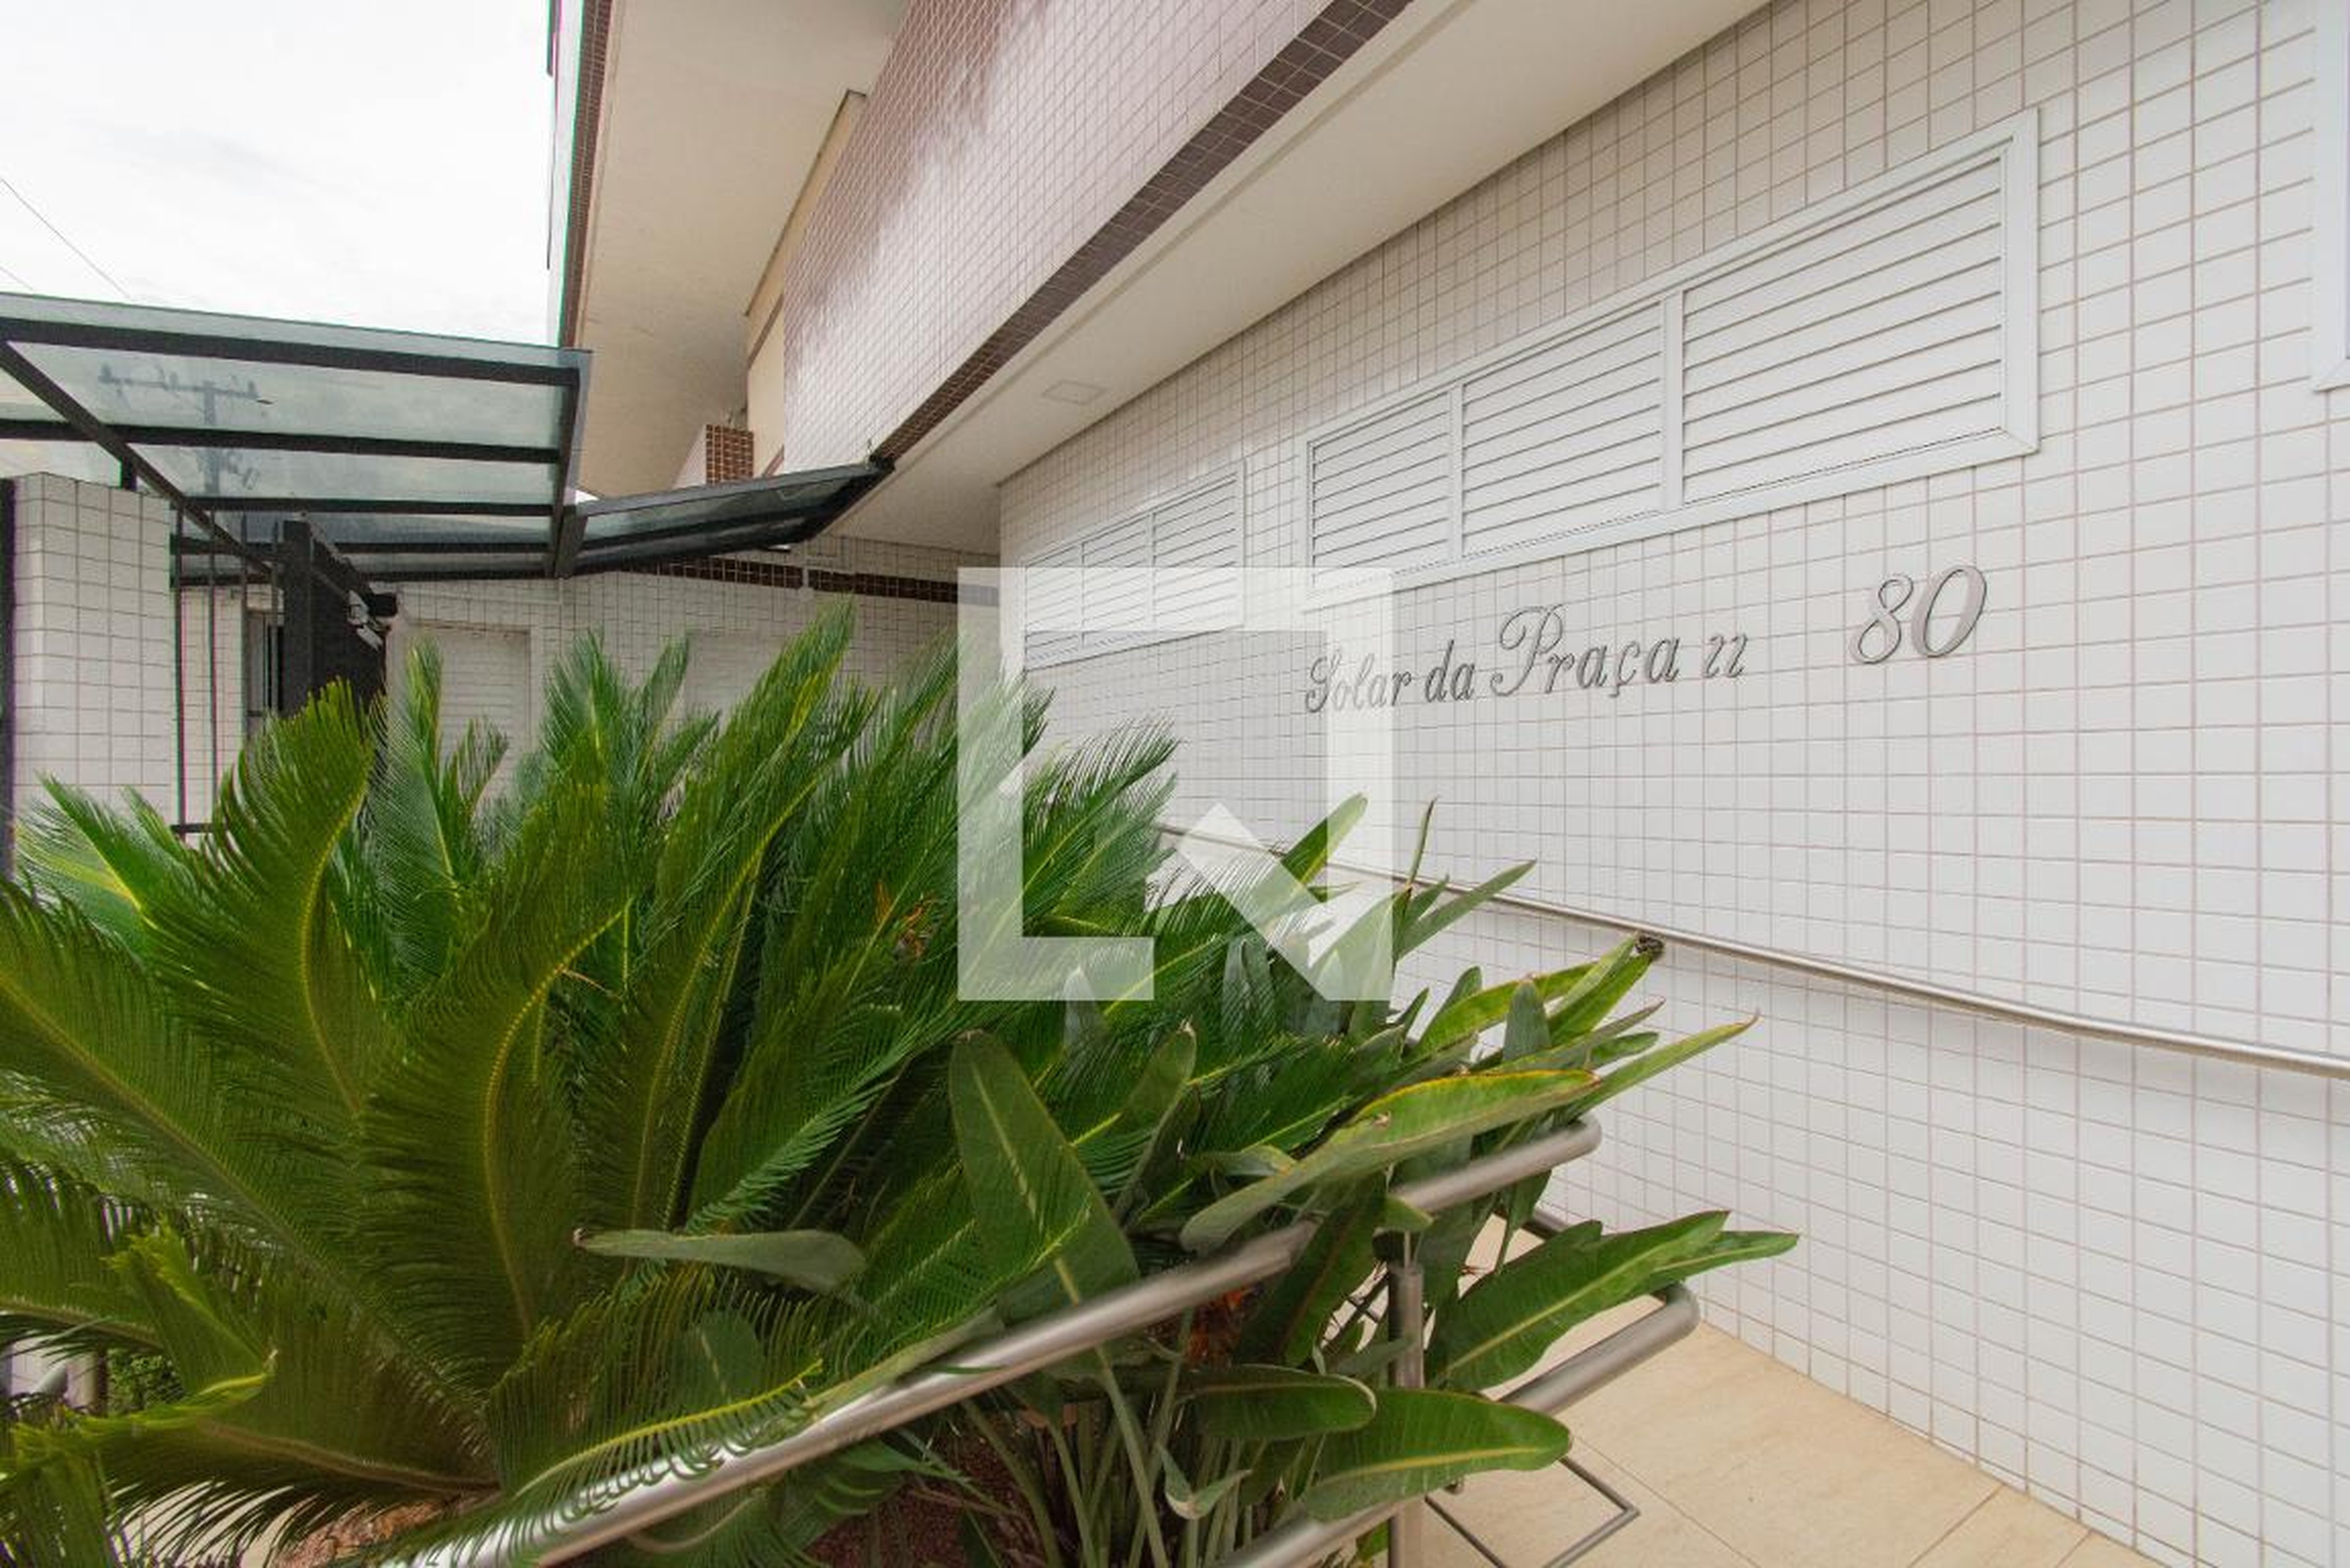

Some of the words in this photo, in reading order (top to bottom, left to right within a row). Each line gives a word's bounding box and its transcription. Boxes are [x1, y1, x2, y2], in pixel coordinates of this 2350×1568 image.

[1305, 652, 1412, 714] Solar
[1425, 639, 1475, 703] da
[1490, 603, 1681, 698] Praça
[1849, 564, 1988, 665] 80
